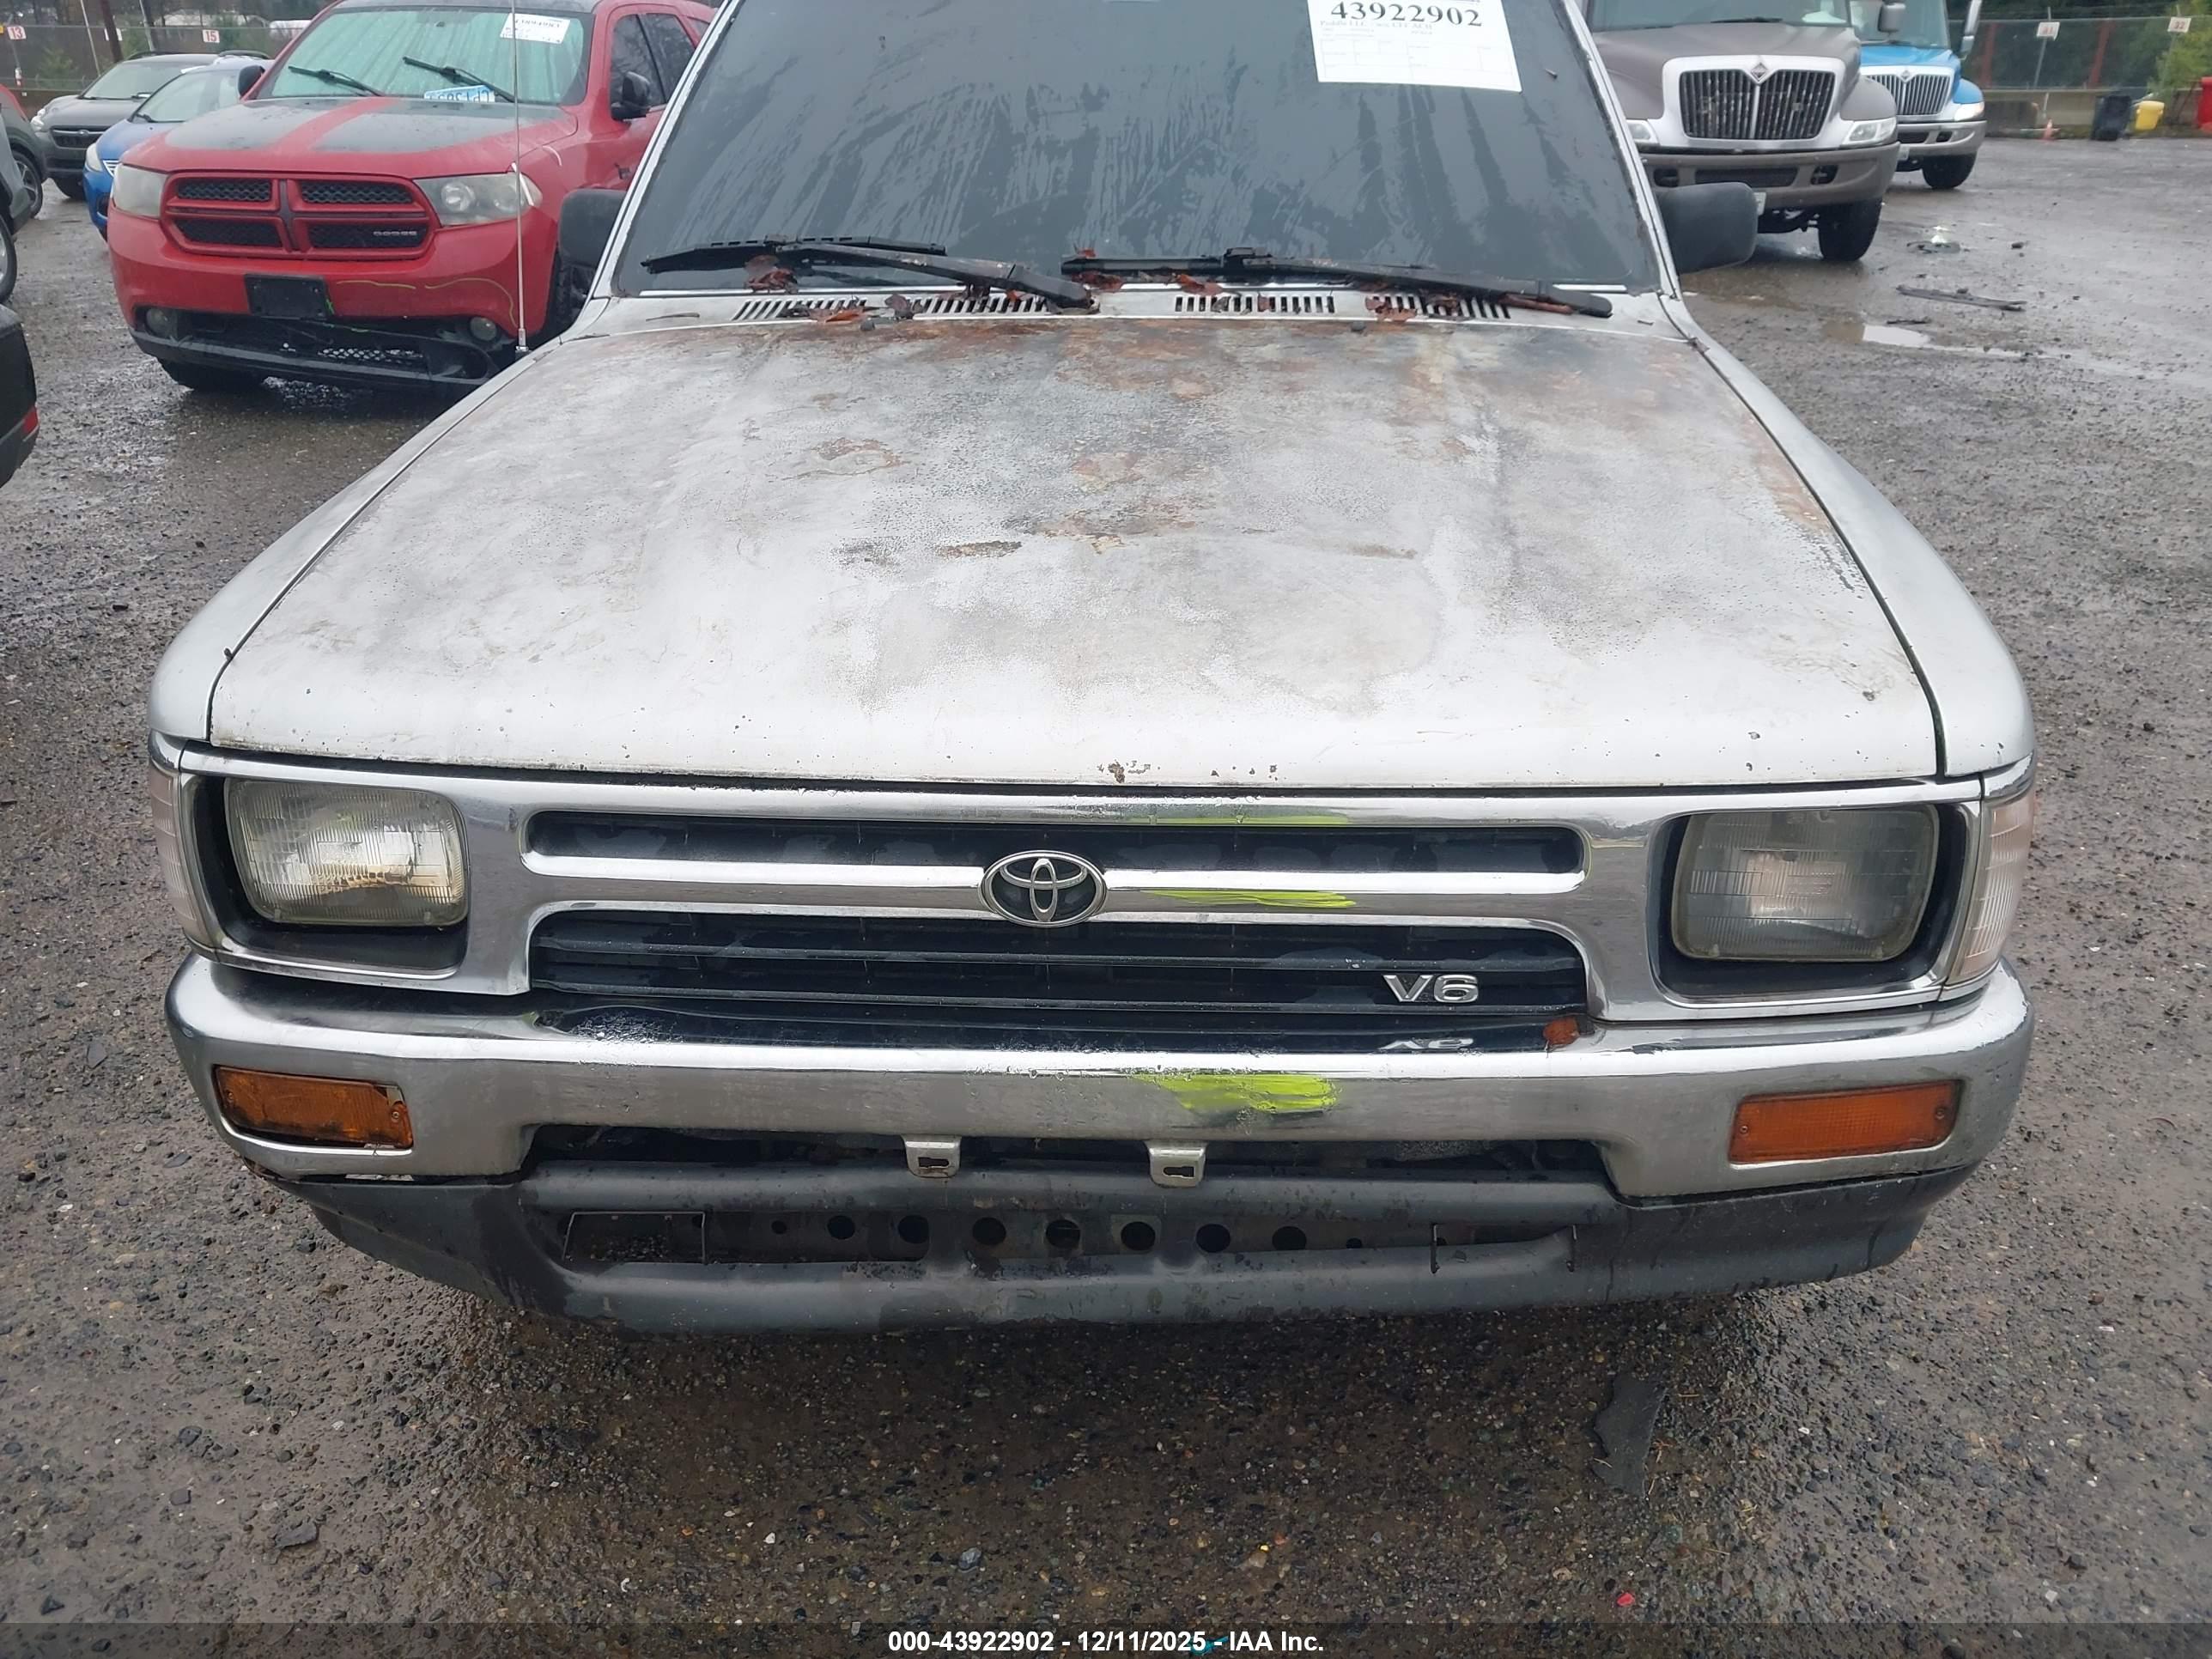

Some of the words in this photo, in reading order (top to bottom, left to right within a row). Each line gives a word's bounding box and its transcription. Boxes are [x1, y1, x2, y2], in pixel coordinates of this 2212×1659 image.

[1331, 1, 1482, 27] 43922902
[10, 27, 23, 40] 13
[206, 30, 217, 42] 15
[1382, 974, 1479, 1003] V6
